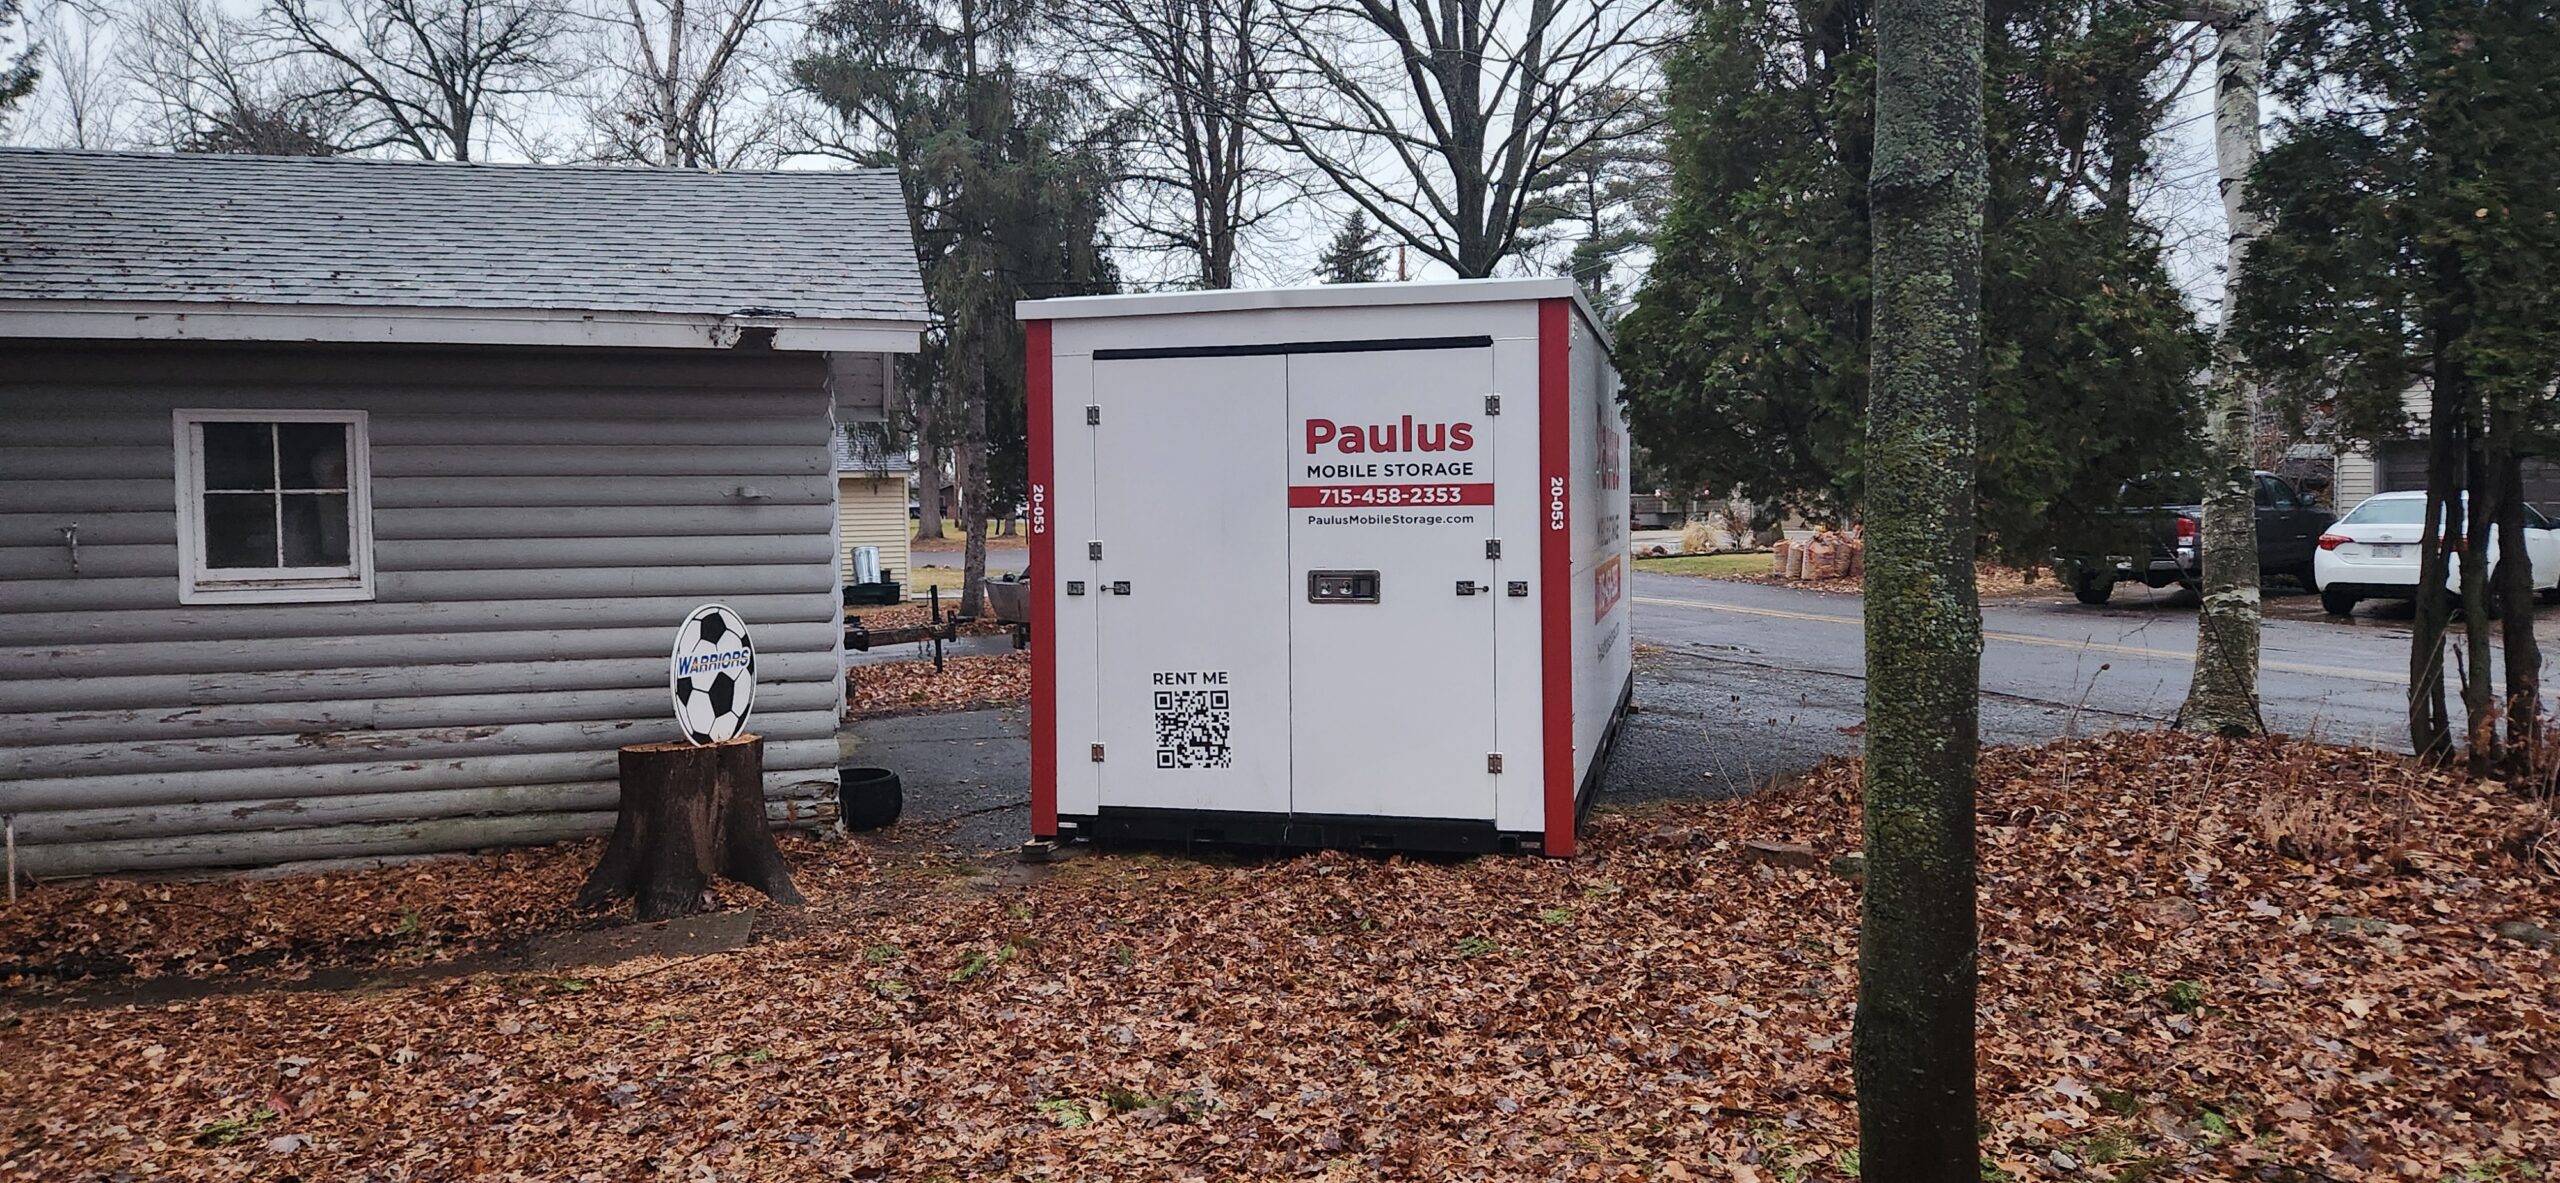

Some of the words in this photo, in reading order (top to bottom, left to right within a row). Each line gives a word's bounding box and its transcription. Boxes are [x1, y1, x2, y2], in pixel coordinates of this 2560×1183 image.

[1306, 415, 1474, 454] Paulus
[1307, 463, 1378, 478] MOBILE
[1384, 462, 1474, 477] STORAGE
[1319, 487, 1461, 504] 715-458-2353
[1551, 476, 1564, 530] 20-053
[1033, 484, 1045, 534] 20-053
[1308, 514, 1474, 526] PaulusMobileStorage.com
[678, 649, 750, 676] WARRIORS
[1153, 672, 1198, 685] RENT
[1203, 671, 1228, 684] ME
